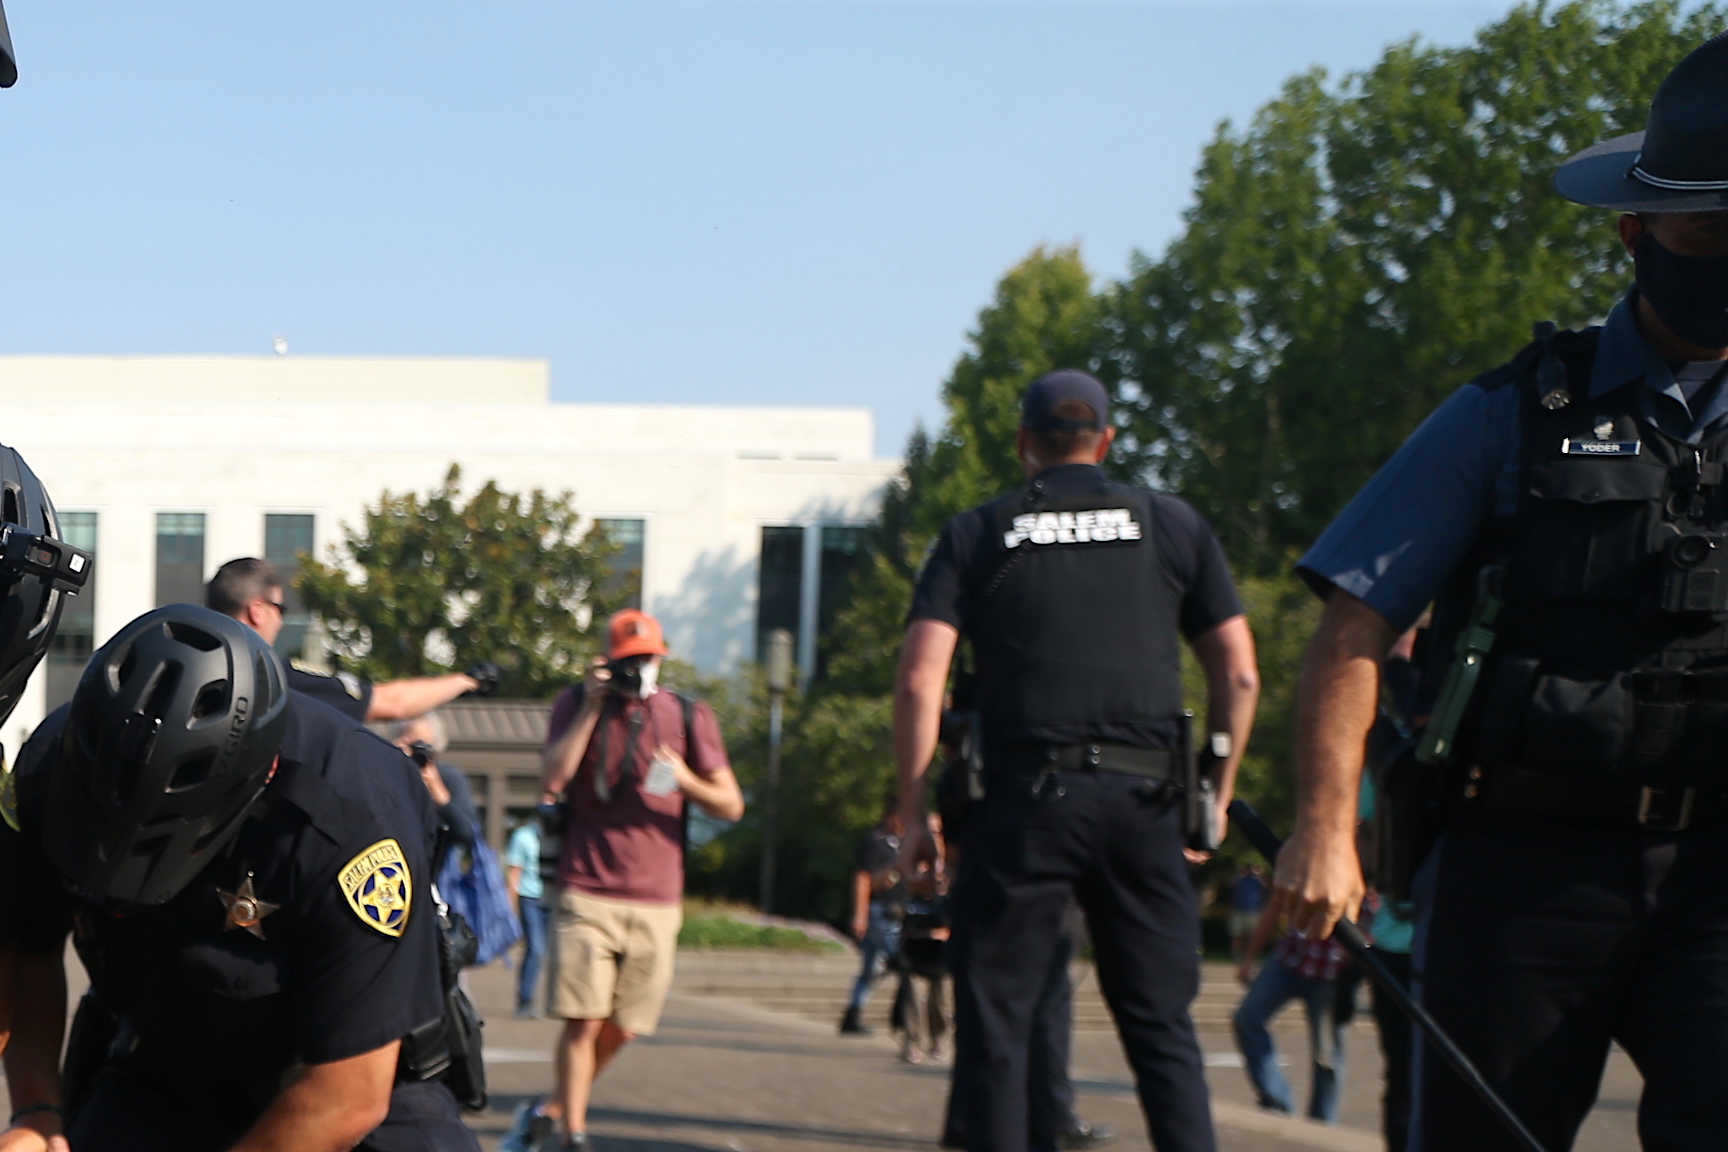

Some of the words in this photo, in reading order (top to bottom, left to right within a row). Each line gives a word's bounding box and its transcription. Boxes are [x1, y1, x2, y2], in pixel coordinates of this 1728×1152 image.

[1580, 442, 1621, 453] YODER
[1012, 508, 1131, 533] SALEM
[1004, 522, 1142, 549] POLICE
[223, 696, 248, 756] GIRO
[345, 855, 373, 890] SALEM
